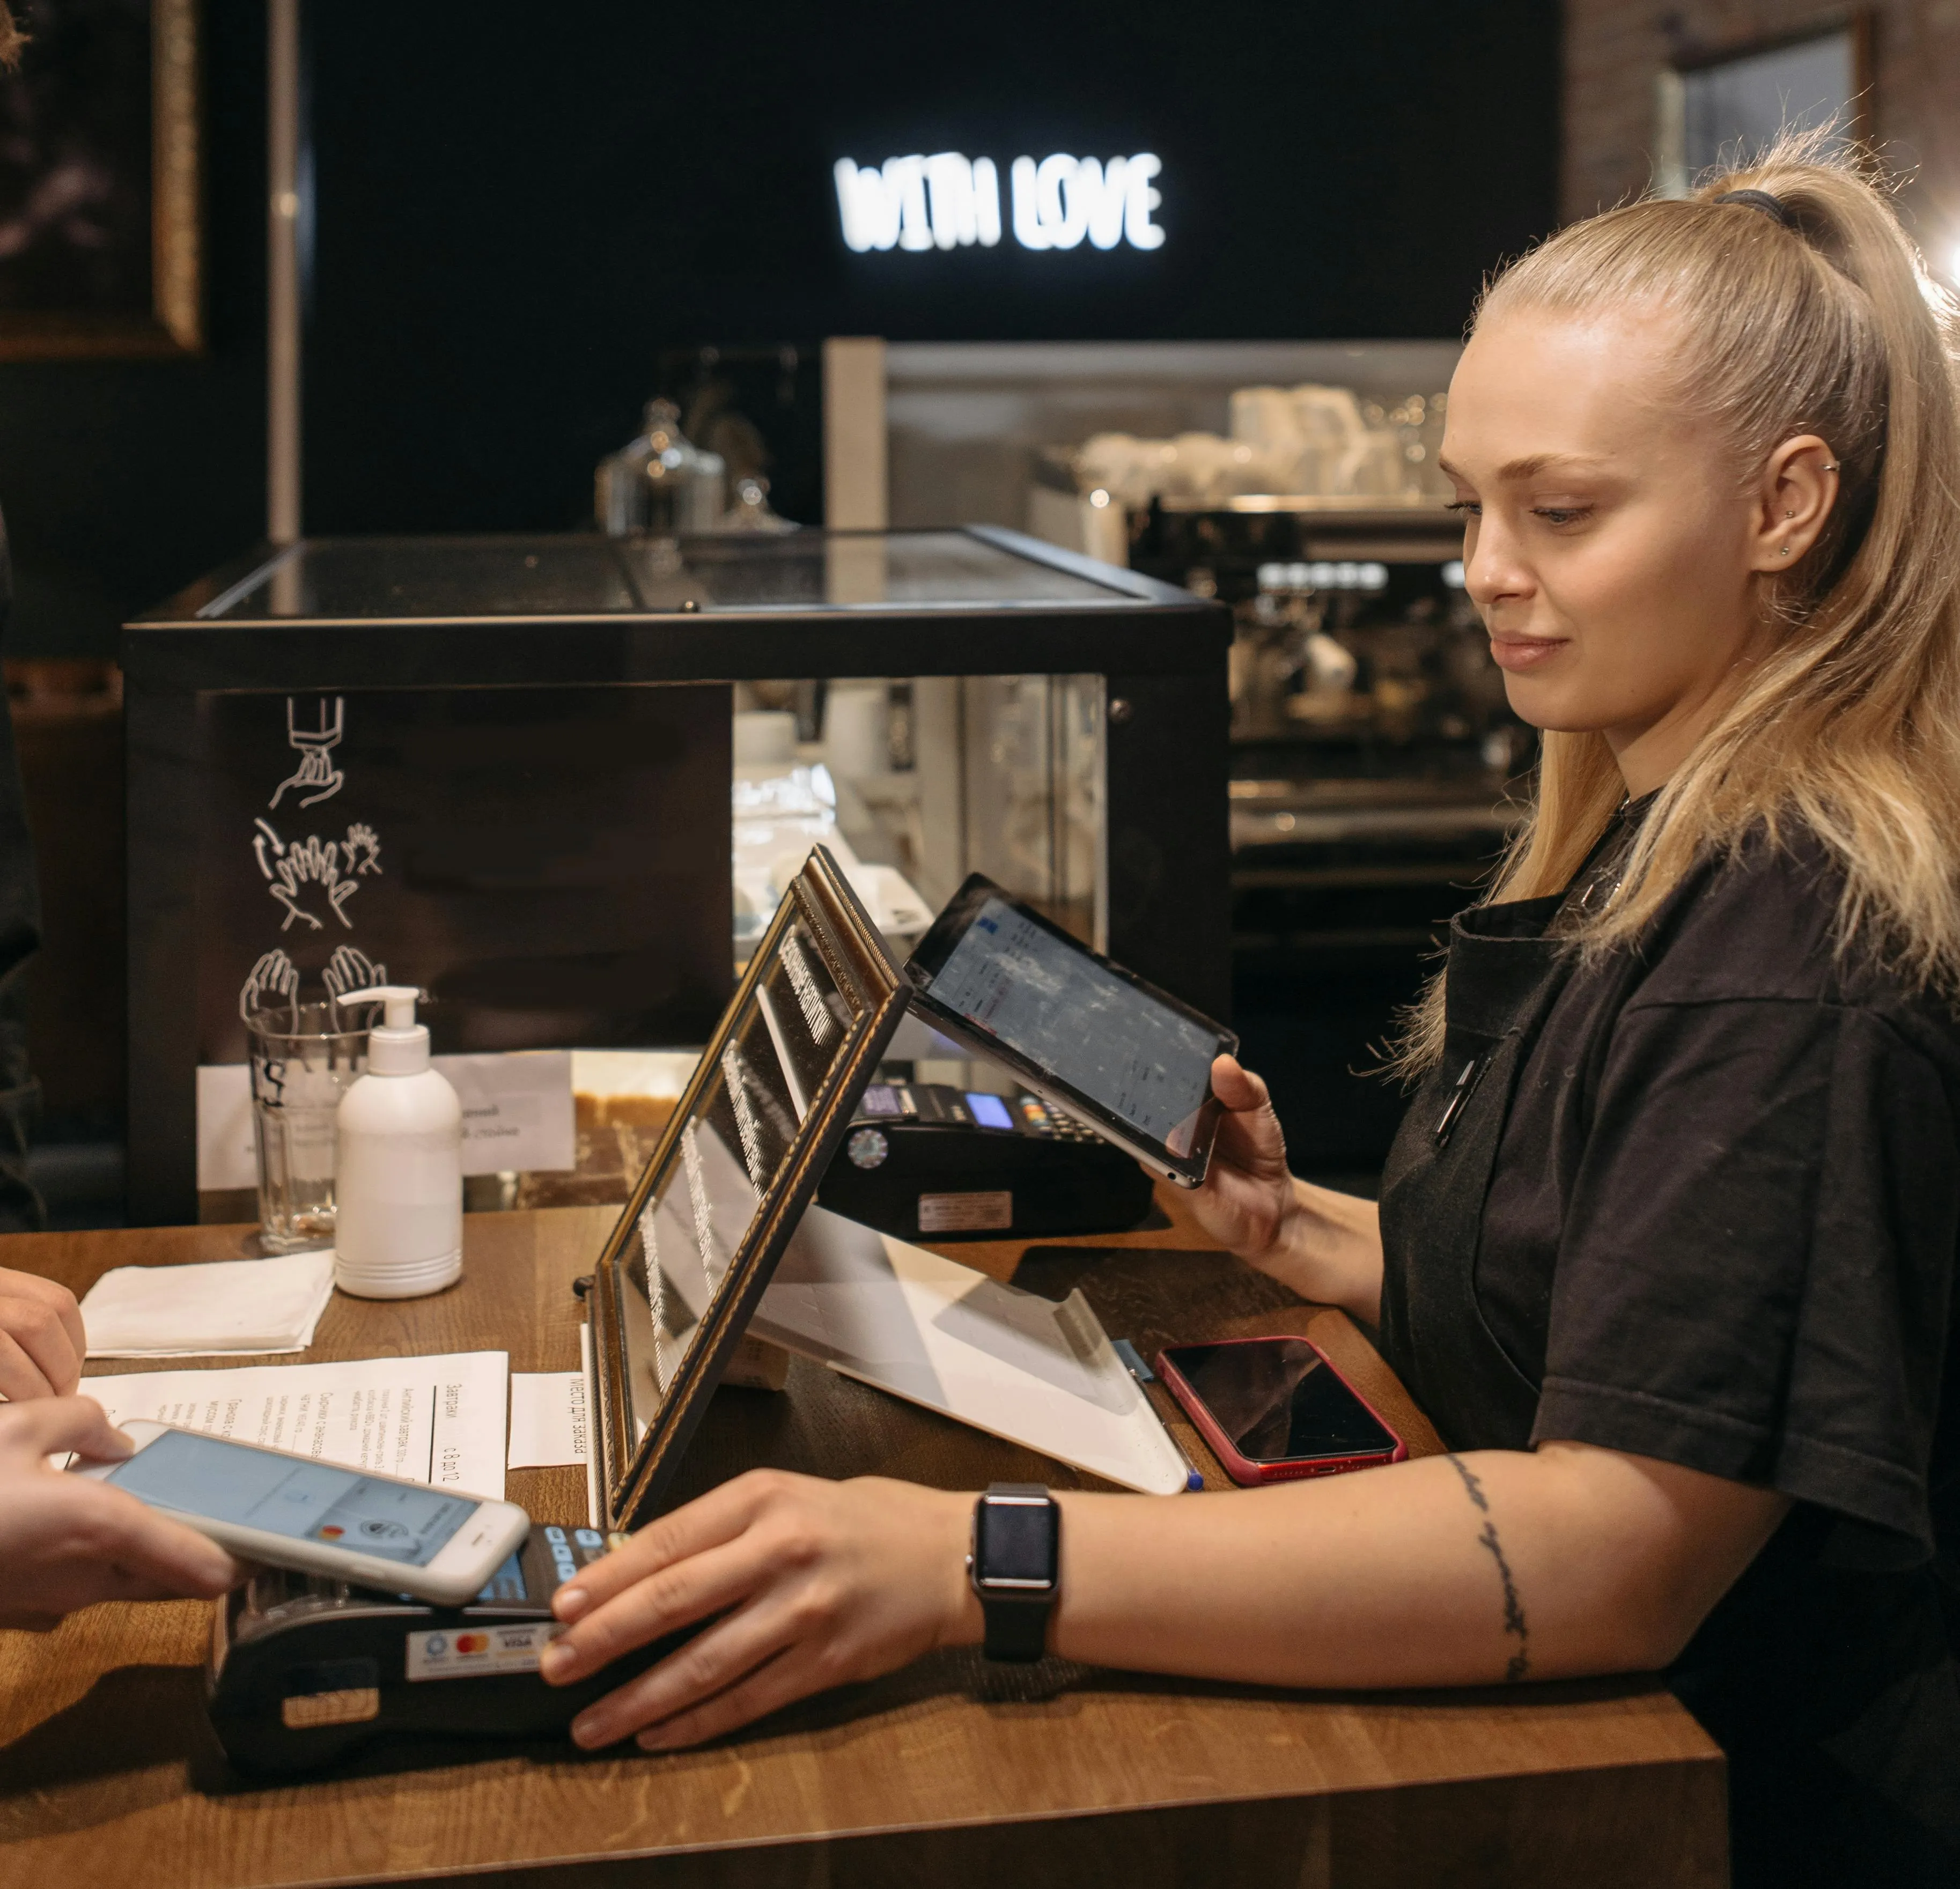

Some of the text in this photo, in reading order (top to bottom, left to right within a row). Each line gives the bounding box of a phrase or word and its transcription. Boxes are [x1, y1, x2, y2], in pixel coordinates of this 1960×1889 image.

[834, 152, 1166, 252] WITH LOVE
[224, 1399, 242, 1425] Гранола
[318, 1392, 333, 1419] Сырники
[400, 1388, 415, 1423] Английский
[444, 1384, 462, 1418] Завтраки
[567, 1379, 587, 1453] Место для заказа
[396, 1425, 411, 1447] завтрак
[440, 1462, 458, 1471] до
[443, 1472, 459, 1481] 12
